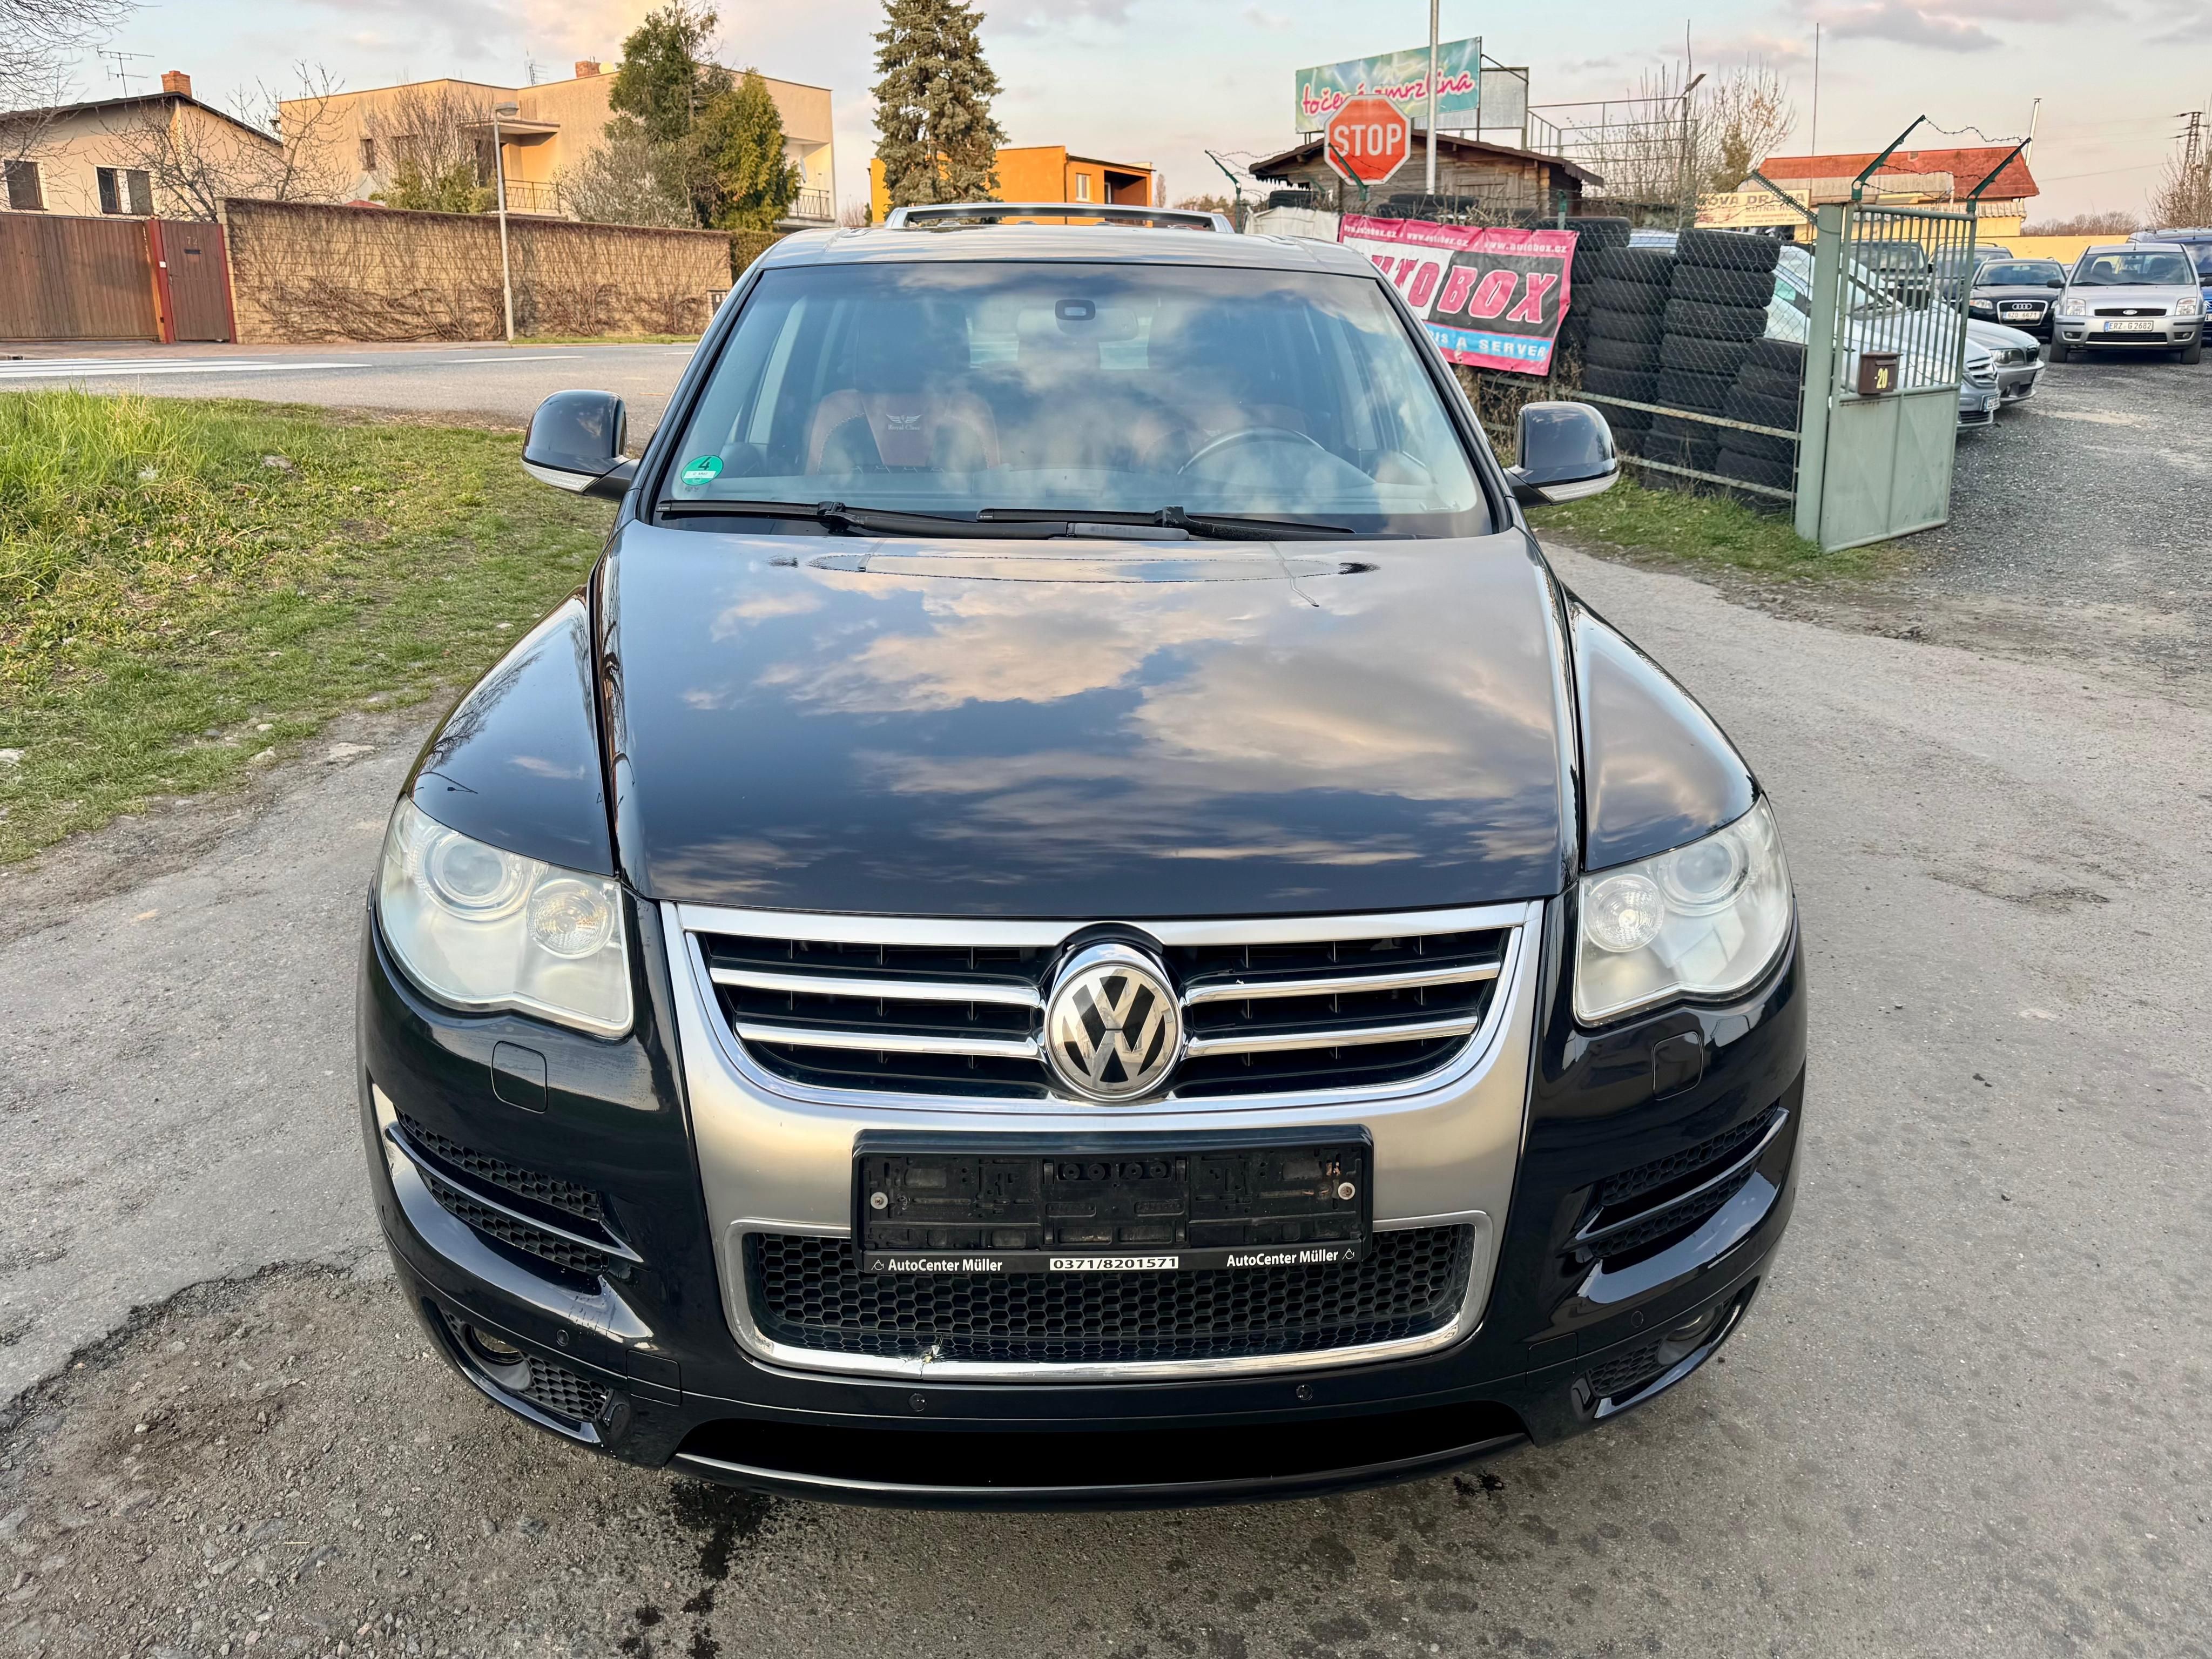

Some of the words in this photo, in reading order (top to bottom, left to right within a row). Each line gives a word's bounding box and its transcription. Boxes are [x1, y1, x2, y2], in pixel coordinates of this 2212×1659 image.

[1333, 123, 1402, 157] STOP
[1479, 339, 1546, 358] SERVER
[1876, 368, 1889, 389] 20
[698, 456, 712, 470] 4
[888, 1259, 960, 1271] AutoCenter
[962, 1258, 1003, 1271] Müller
[1054, 1258, 1176, 1269] 0371/8201571
[1226, 1253, 1297, 1267] AutoCenter
[1299, 1249, 1339, 1263] Müller
